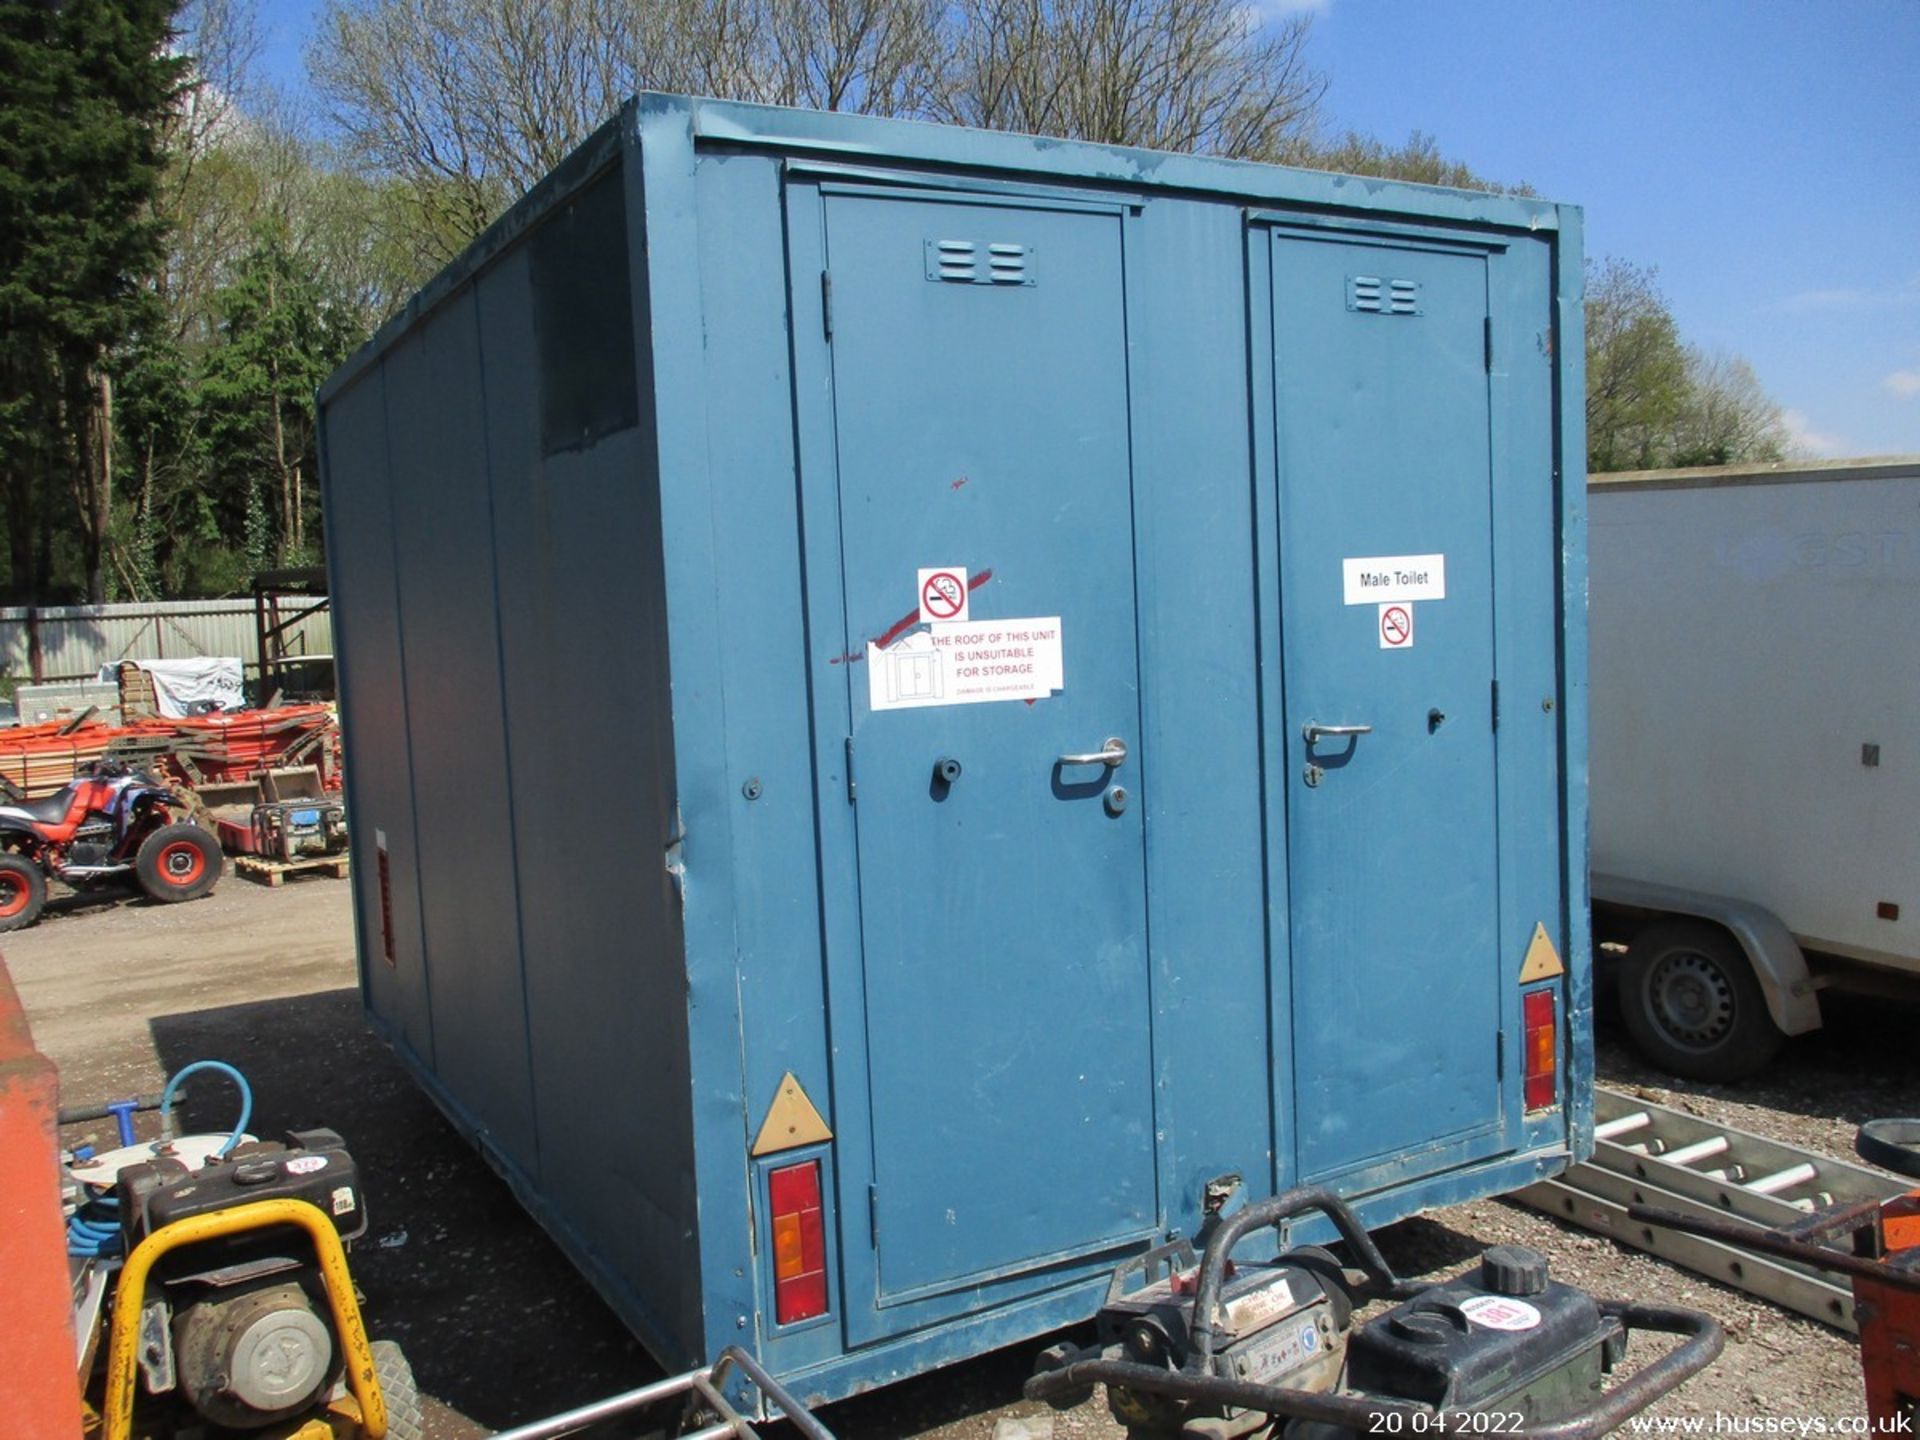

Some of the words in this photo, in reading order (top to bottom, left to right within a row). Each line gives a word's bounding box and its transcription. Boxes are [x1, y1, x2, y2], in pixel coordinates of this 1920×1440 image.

[1360, 572, 1391, 588] Male
[1393, 570, 1429, 586] Toilet
[930, 635, 952, 647] THE
[954, 633, 985, 645] ROOF
[988, 632, 1002, 644] OF
[1006, 631, 1030, 643] THIS
[1031, 630, 1056, 641] UNIT
[954, 651, 965, 662] IS
[967, 647, 1034, 661] UNSUITABLE
[956, 666, 980, 678] FOR
[982, 663, 1033, 676] STORAGE
